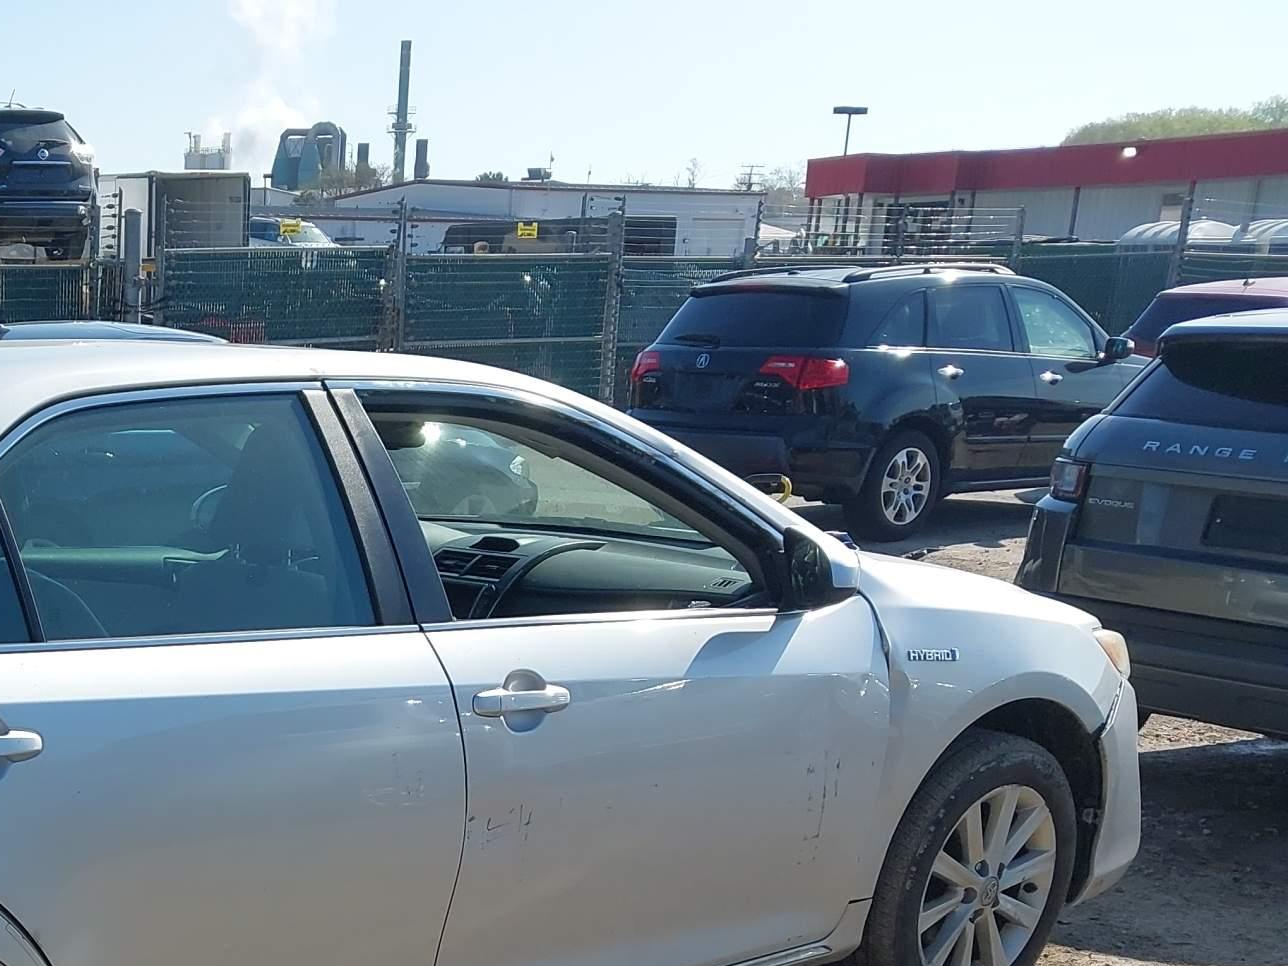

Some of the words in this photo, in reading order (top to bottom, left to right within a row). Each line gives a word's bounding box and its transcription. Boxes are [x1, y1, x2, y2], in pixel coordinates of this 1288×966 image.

[1142, 440, 1257, 460] RANGE
[1088, 497, 1135, 509] EVOQUE
[910, 649, 953, 661] HYBRID
